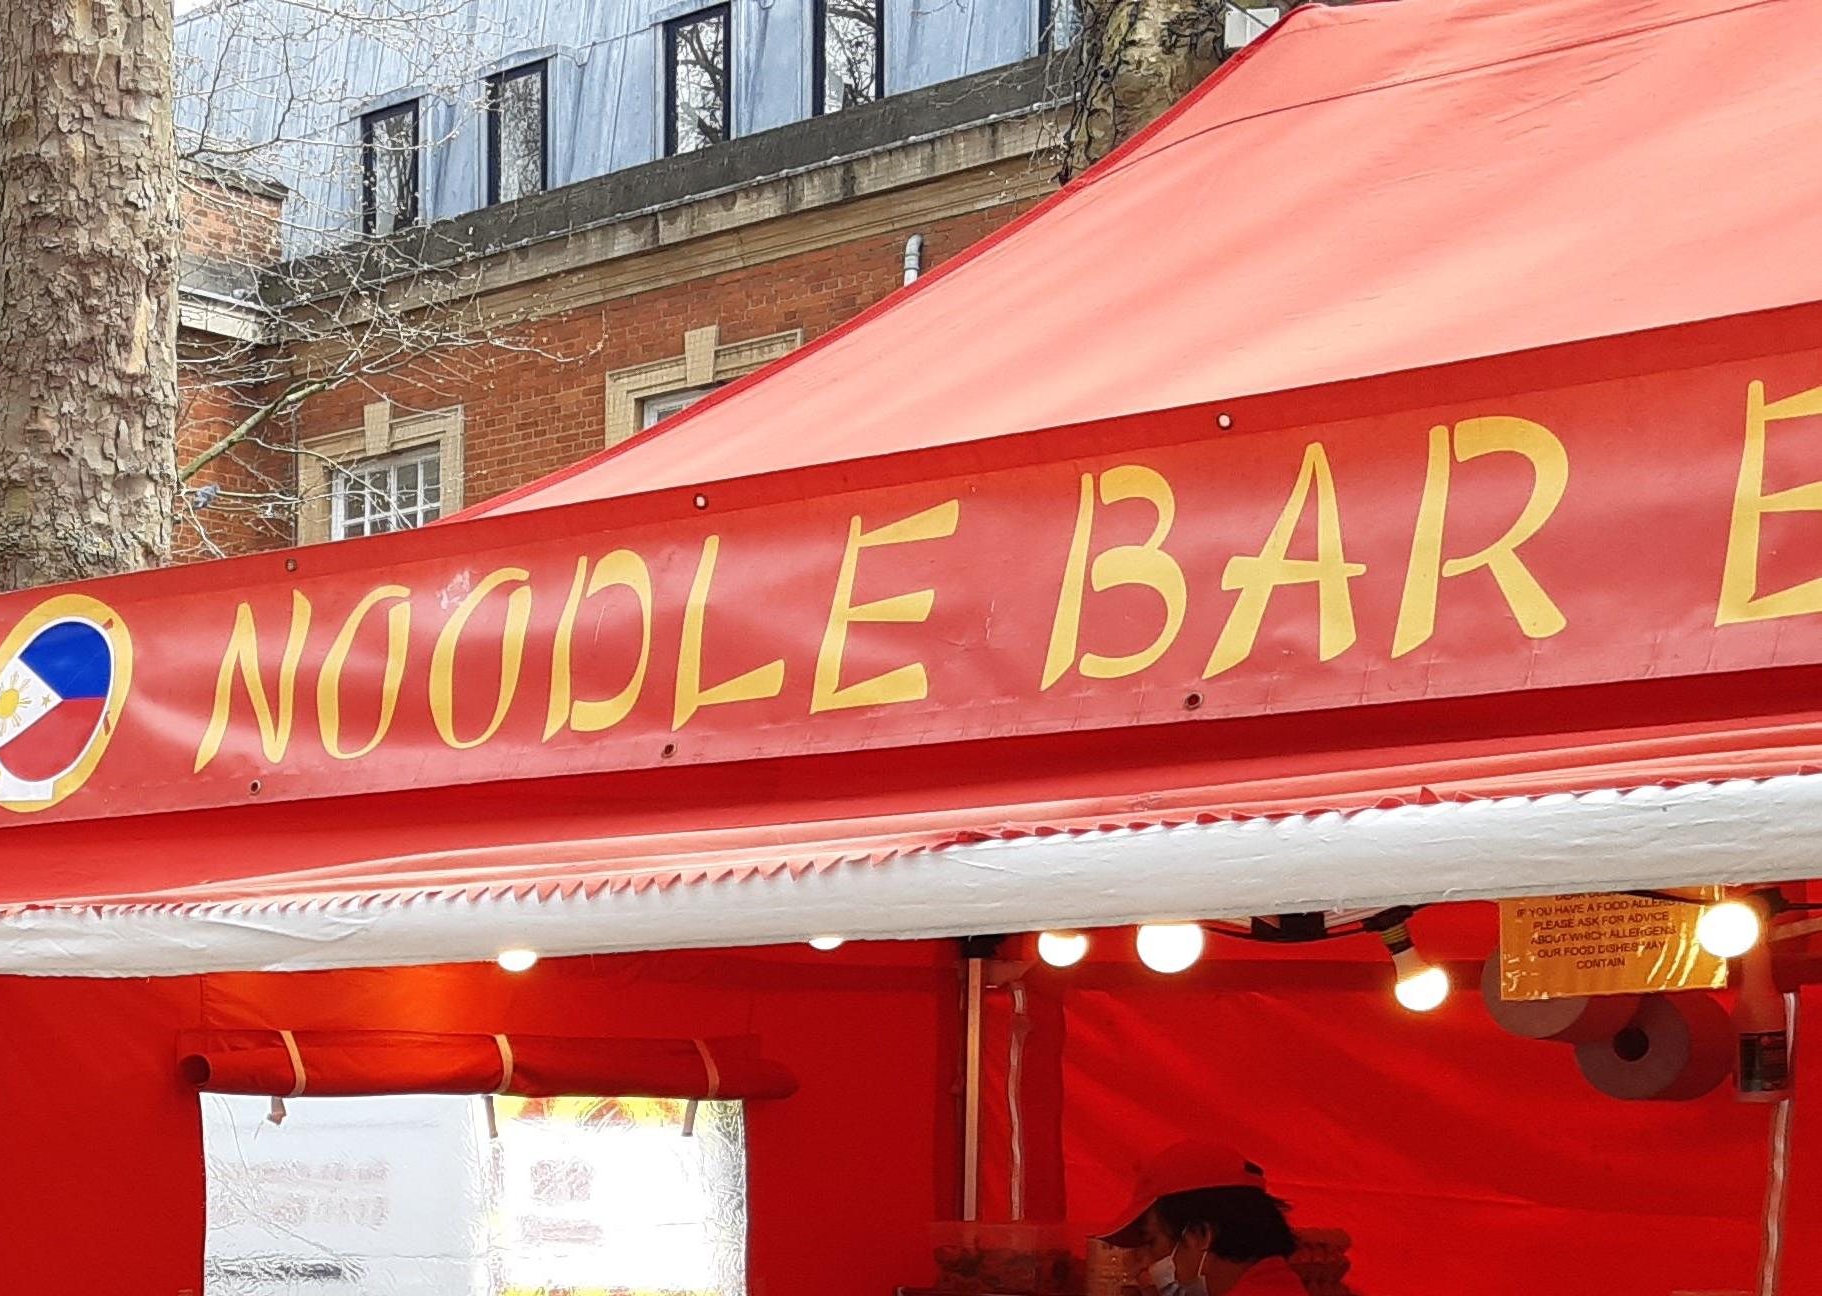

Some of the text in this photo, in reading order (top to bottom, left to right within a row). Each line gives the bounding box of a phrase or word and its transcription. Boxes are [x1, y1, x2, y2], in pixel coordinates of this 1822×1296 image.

[192, 500, 962, 774] NOODLE
[1040, 416, 1569, 692] BAR
[1528, 901, 1628, 918] YOU HAVE FOOD
[1533, 911, 1669, 931] PLEASE ASK FOR ADVICE
[1530, 926, 1677, 945] ABOUT WHICH ALLERGENS
[1537, 942, 1638, 958] OUR FOOD DISHES
[1576, 957, 1626, 970] CONTAIN
